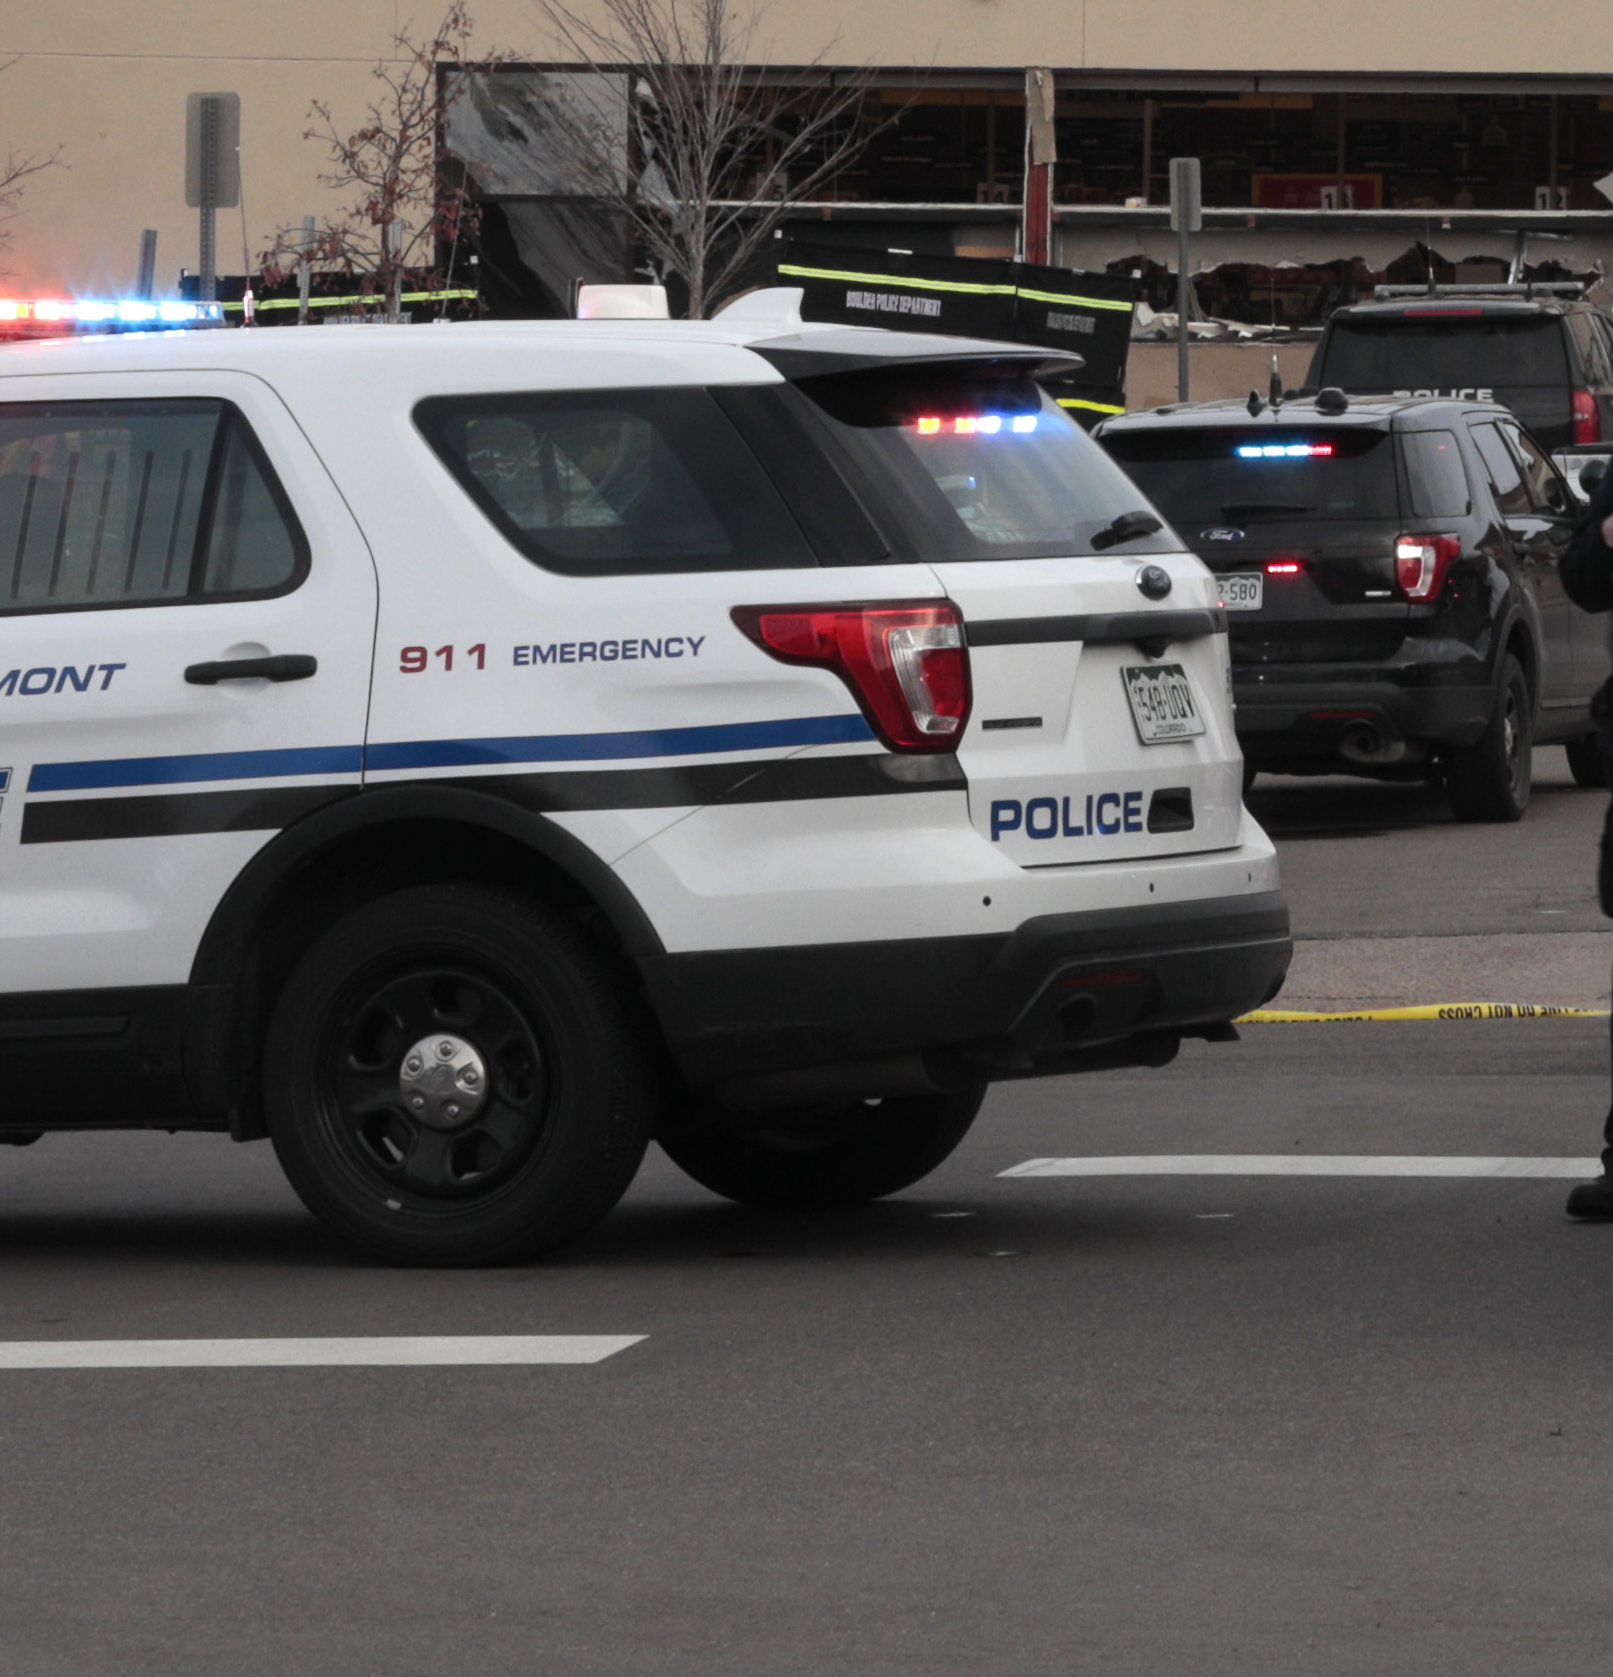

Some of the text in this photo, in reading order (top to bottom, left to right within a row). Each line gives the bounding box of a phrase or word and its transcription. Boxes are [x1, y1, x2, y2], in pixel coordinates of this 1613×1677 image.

[399, 636, 706, 674] 911 EMERGENCY
[990, 790, 1144, 842] POLICE
